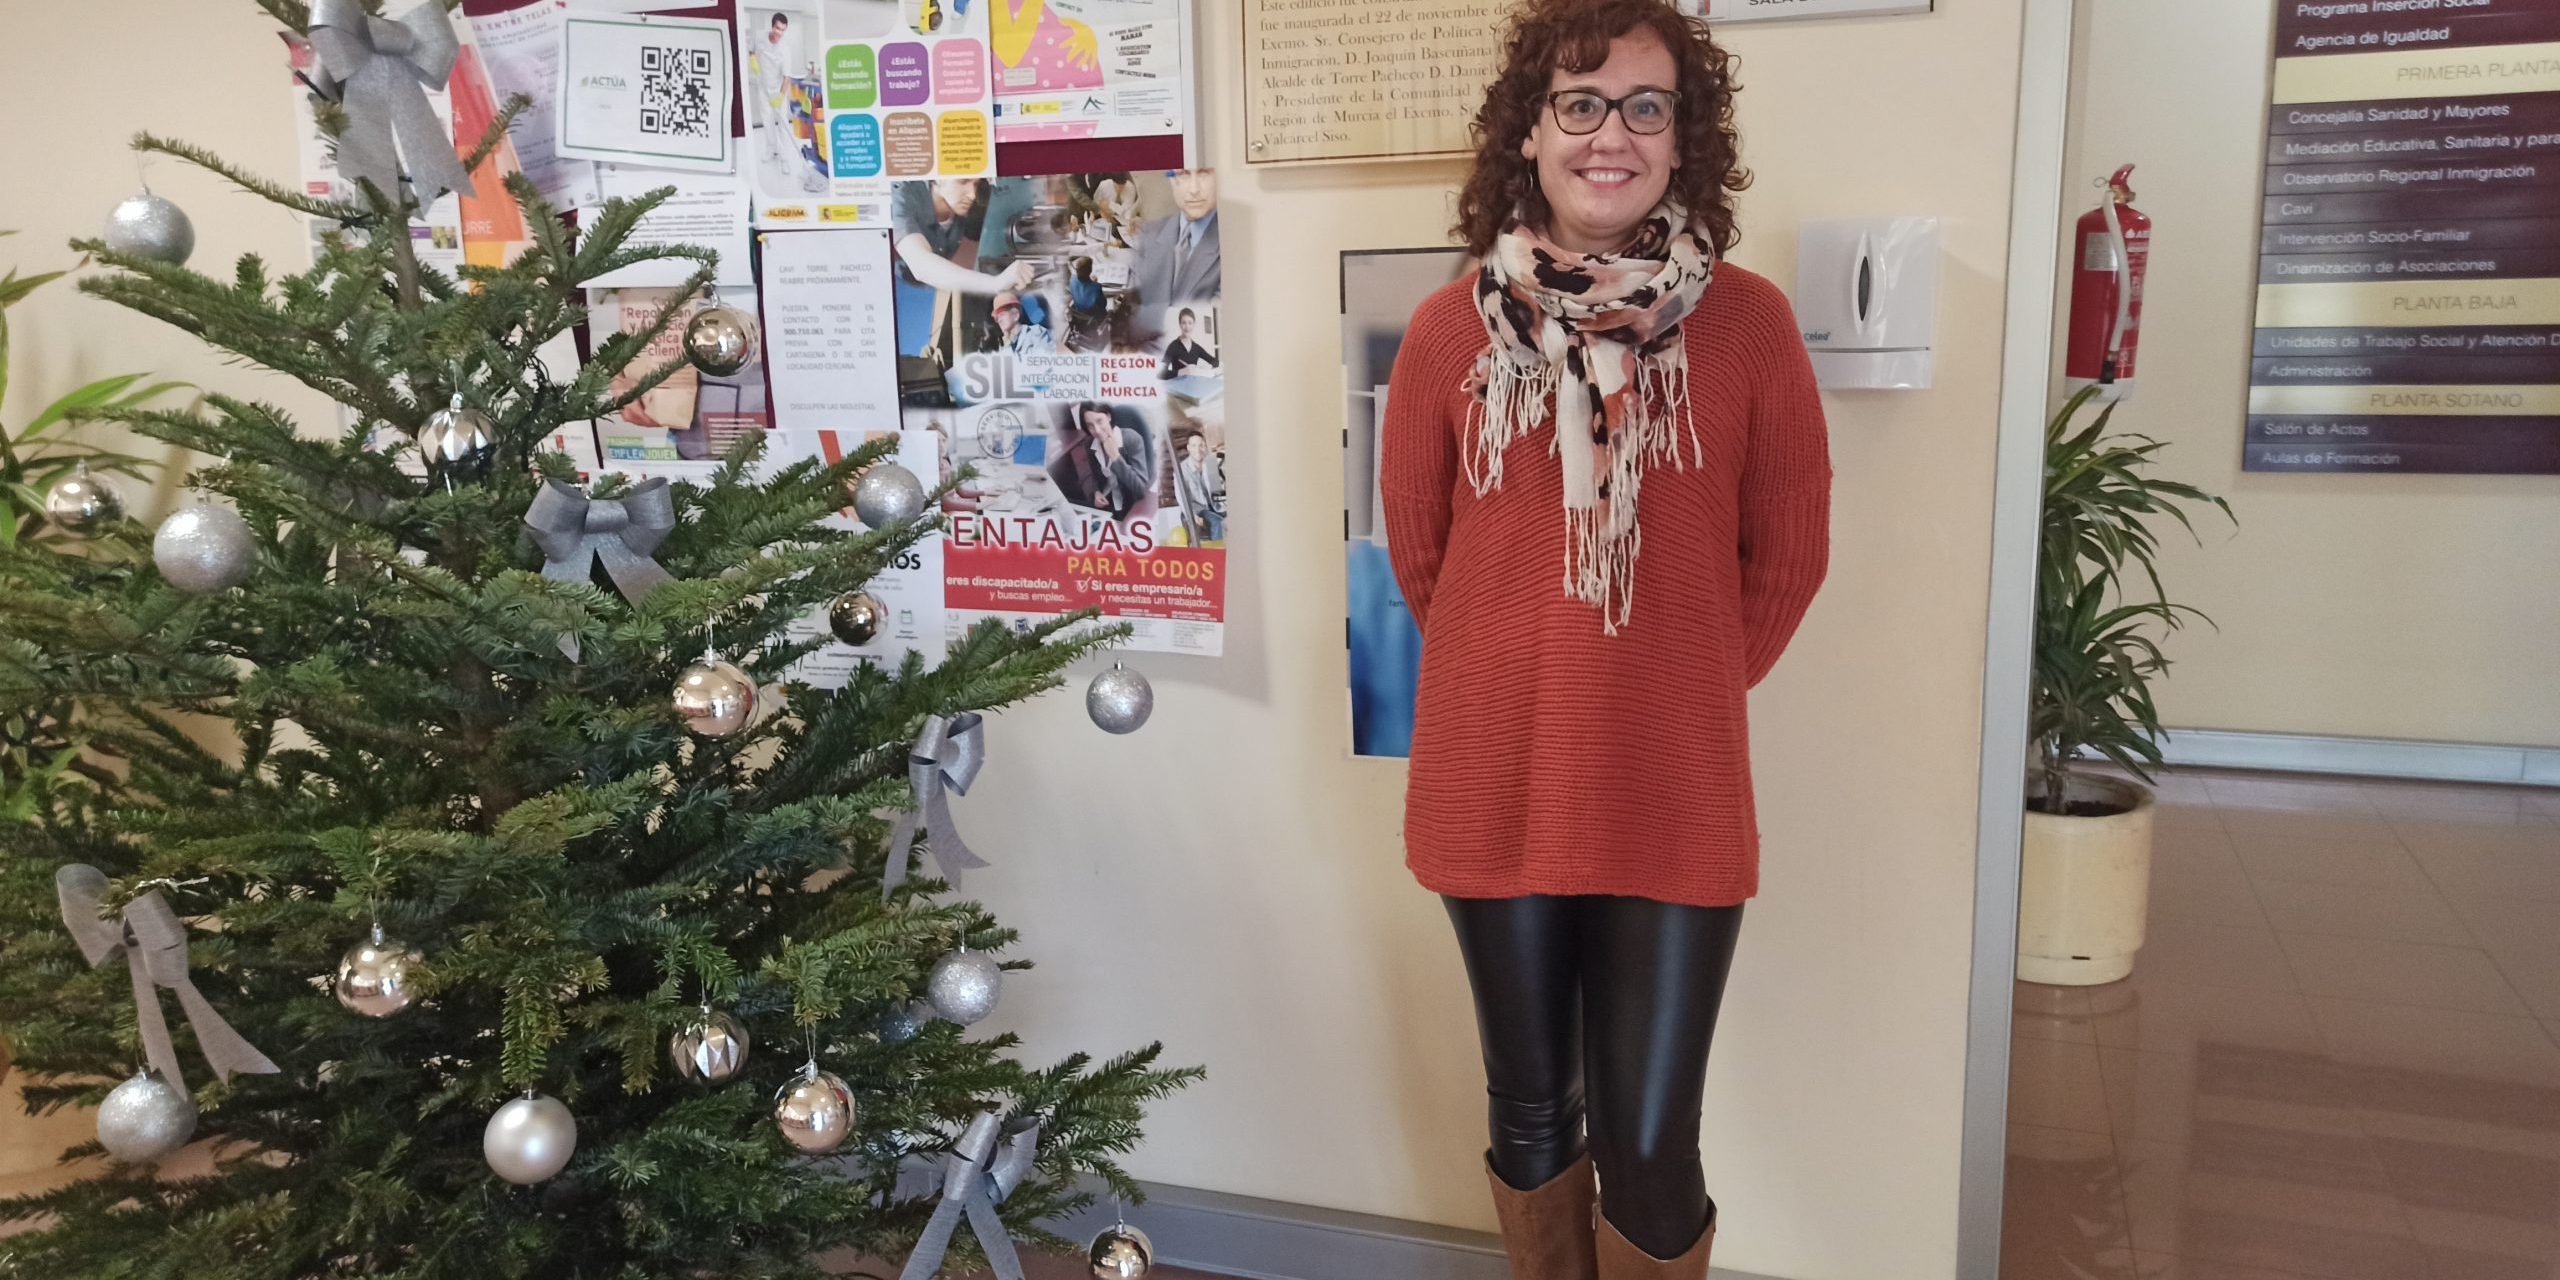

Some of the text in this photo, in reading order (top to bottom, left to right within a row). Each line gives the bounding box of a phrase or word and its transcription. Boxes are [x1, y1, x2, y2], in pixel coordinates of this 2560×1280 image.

[1260, 20, 1279, 31] fue
[1284, 13, 1354, 30] inaugurada
[1359, 11, 1370, 24] el
[1375, 10, 1392, 24] 22
[1396, 9, 1412, 22] de
[1418, 4, 1489, 21] noviembre
[2296, 2, 2369, 18] Programa
[1261, 37, 1309, 50] Excmo.
[1338, 31, 1405, 46] Consejero
[1410, 28, 1427, 41] de
[2296, 27, 2450, 49] Agencia de Igualdad
[891, 56, 915, 65] ¿Estás
[833, 71, 868, 80] buscando
[886, 69, 922, 78] buscando
[1263, 75, 1307, 89] Alcalde
[1311, 73, 1327, 85] de
[1330, 71, 1367, 84] Torre
[1371, 68, 1424, 83] Pacheco
[1450, 63, 1494, 77] Daniel
[2397, 60, 2560, 81] PRIMERA PLANTA
[590, 77, 627, 87] ACTÚA
[889, 80, 920, 90] trabajo?
[1275, 92, 1343, 107] Presidente
[1350, 90, 1366, 103] de
[1372, 89, 1383, 101] la
[1390, 83, 1470, 100] Comunidad
[1312, 112, 1328, 124] de
[1334, 109, 1379, 122] Murcia
[1385, 107, 1397, 120] el
[1403, 106, 1453, 119] Excmo.
[2367, 107, 2428, 122] Sanidad
[2432, 109, 2441, 121] y
[2445, 105, 2510, 119] Mayores
[2286, 141, 2359, 156] Mediación
[2444, 135, 2510, 149] Sanitaria
[2514, 136, 2524, 148] y
[2527, 133, 2560, 148] para
[2284, 164, 2535, 186] Observatorio Regional Inmigración
[2281, 203, 2313, 216] Cavi
[2278, 229, 2471, 246] Intervención Socio-Familiar
[779, 263, 872, 273] CAVI TORRE PACHECO
[2276, 258, 2497, 275] Dinamización de Asociaciones
[782, 304, 875, 312] PUEDEN PONERSE EN
[2392, 294, 2518, 311] PLANTA BAJA
[782, 316, 820, 324] CONTACTO
[834, 327, 852, 335] PARA
[860, 327, 876, 335] CITA
[785, 339, 808, 348] PREVIA
[827, 339, 842, 347] CON
[2271, 335, 2337, 348] Unidades
[2340, 336, 2360, 348] de
[2364, 336, 2418, 351] Trabajo
[2420, 335, 2464, 348] Social
[2467, 337, 2476, 350] y
[2481, 332, 2547, 347] Atención
[785, 351, 826, 359] CARTAGENA
[843, 351, 853, 359] DE
[859, 350, 877, 358] OTRA
[1026, 355, 1089, 367] SERVICIO DE
[786, 362, 823, 371] LOCALIDAD
[1100, 356, 1156, 369] REGIÓN
[965, 354, 1035, 400] SIL
[1021, 372, 1090, 384] INTEGRACIÓN
[1101, 372, 1118, 383] DE
[2269, 363, 2372, 379] Administración
[1043, 388, 1089, 399] LABORAL
[1101, 386, 1157, 397] MURCIA
[790, 402, 825, 411] DISCULPEN
[827, 403, 839, 411] LAS
[2370, 393, 2524, 408] PLANTA SOTANO
[2264, 421, 2368, 437] Salón de Actos
[2262, 450, 2401, 465] Aulas de Formación
[954, 515, 1154, 553] ENTAJAS
[1067, 557, 1215, 581] PARA TODOS
[946, 575, 1059, 590] eres discapacitado/a
[1091, 579, 1204, 597] Si eres empresario/a
[990, 590, 995, 601] y
[997, 589, 1029, 600] buscas
[1100, 594, 1106, 604] y
[1108, 592, 1152, 604] necesitas
[1154, 596, 1166, 605] un
